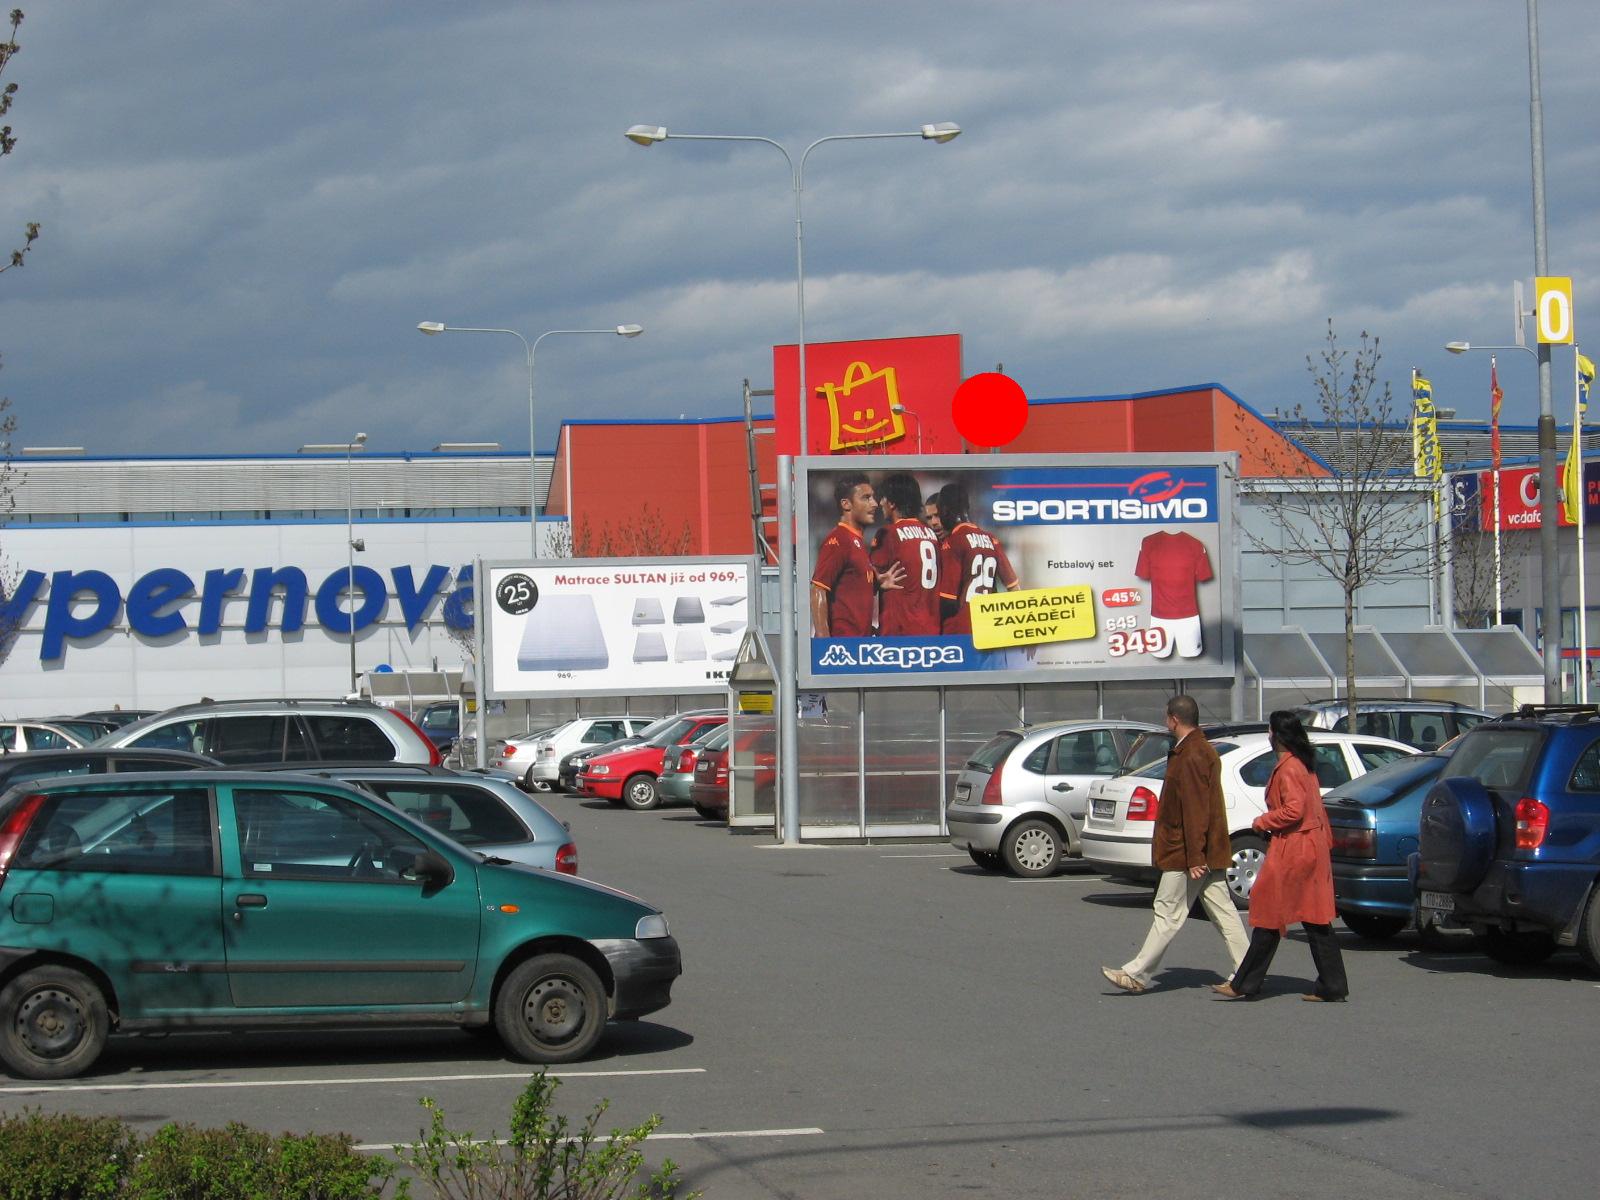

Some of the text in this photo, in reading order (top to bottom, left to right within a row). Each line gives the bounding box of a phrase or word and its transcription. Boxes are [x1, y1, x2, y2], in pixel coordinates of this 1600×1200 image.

[919, 540, 938, 590] 8
[1047, 560, 1114, 570] Fotbalový set
[554, 575, 610, 585] Matrace
[614, 573, 667, 584] SULTAN
[670, 572, 685, 586] již
[688, 572, 706, 583] od
[504, 581, 530, 605] 25
[980, 591, 1087, 614] MIMOŘÁDNÉ
[993, 607, 1076, 627] ZAVÁDĚCÍ
[1105, 615, 1137, 631] 649
[1013, 625, 1059, 640] CENY
[1107, 627, 1165, 658] 349
[859, 643, 964, 668] Kappa
